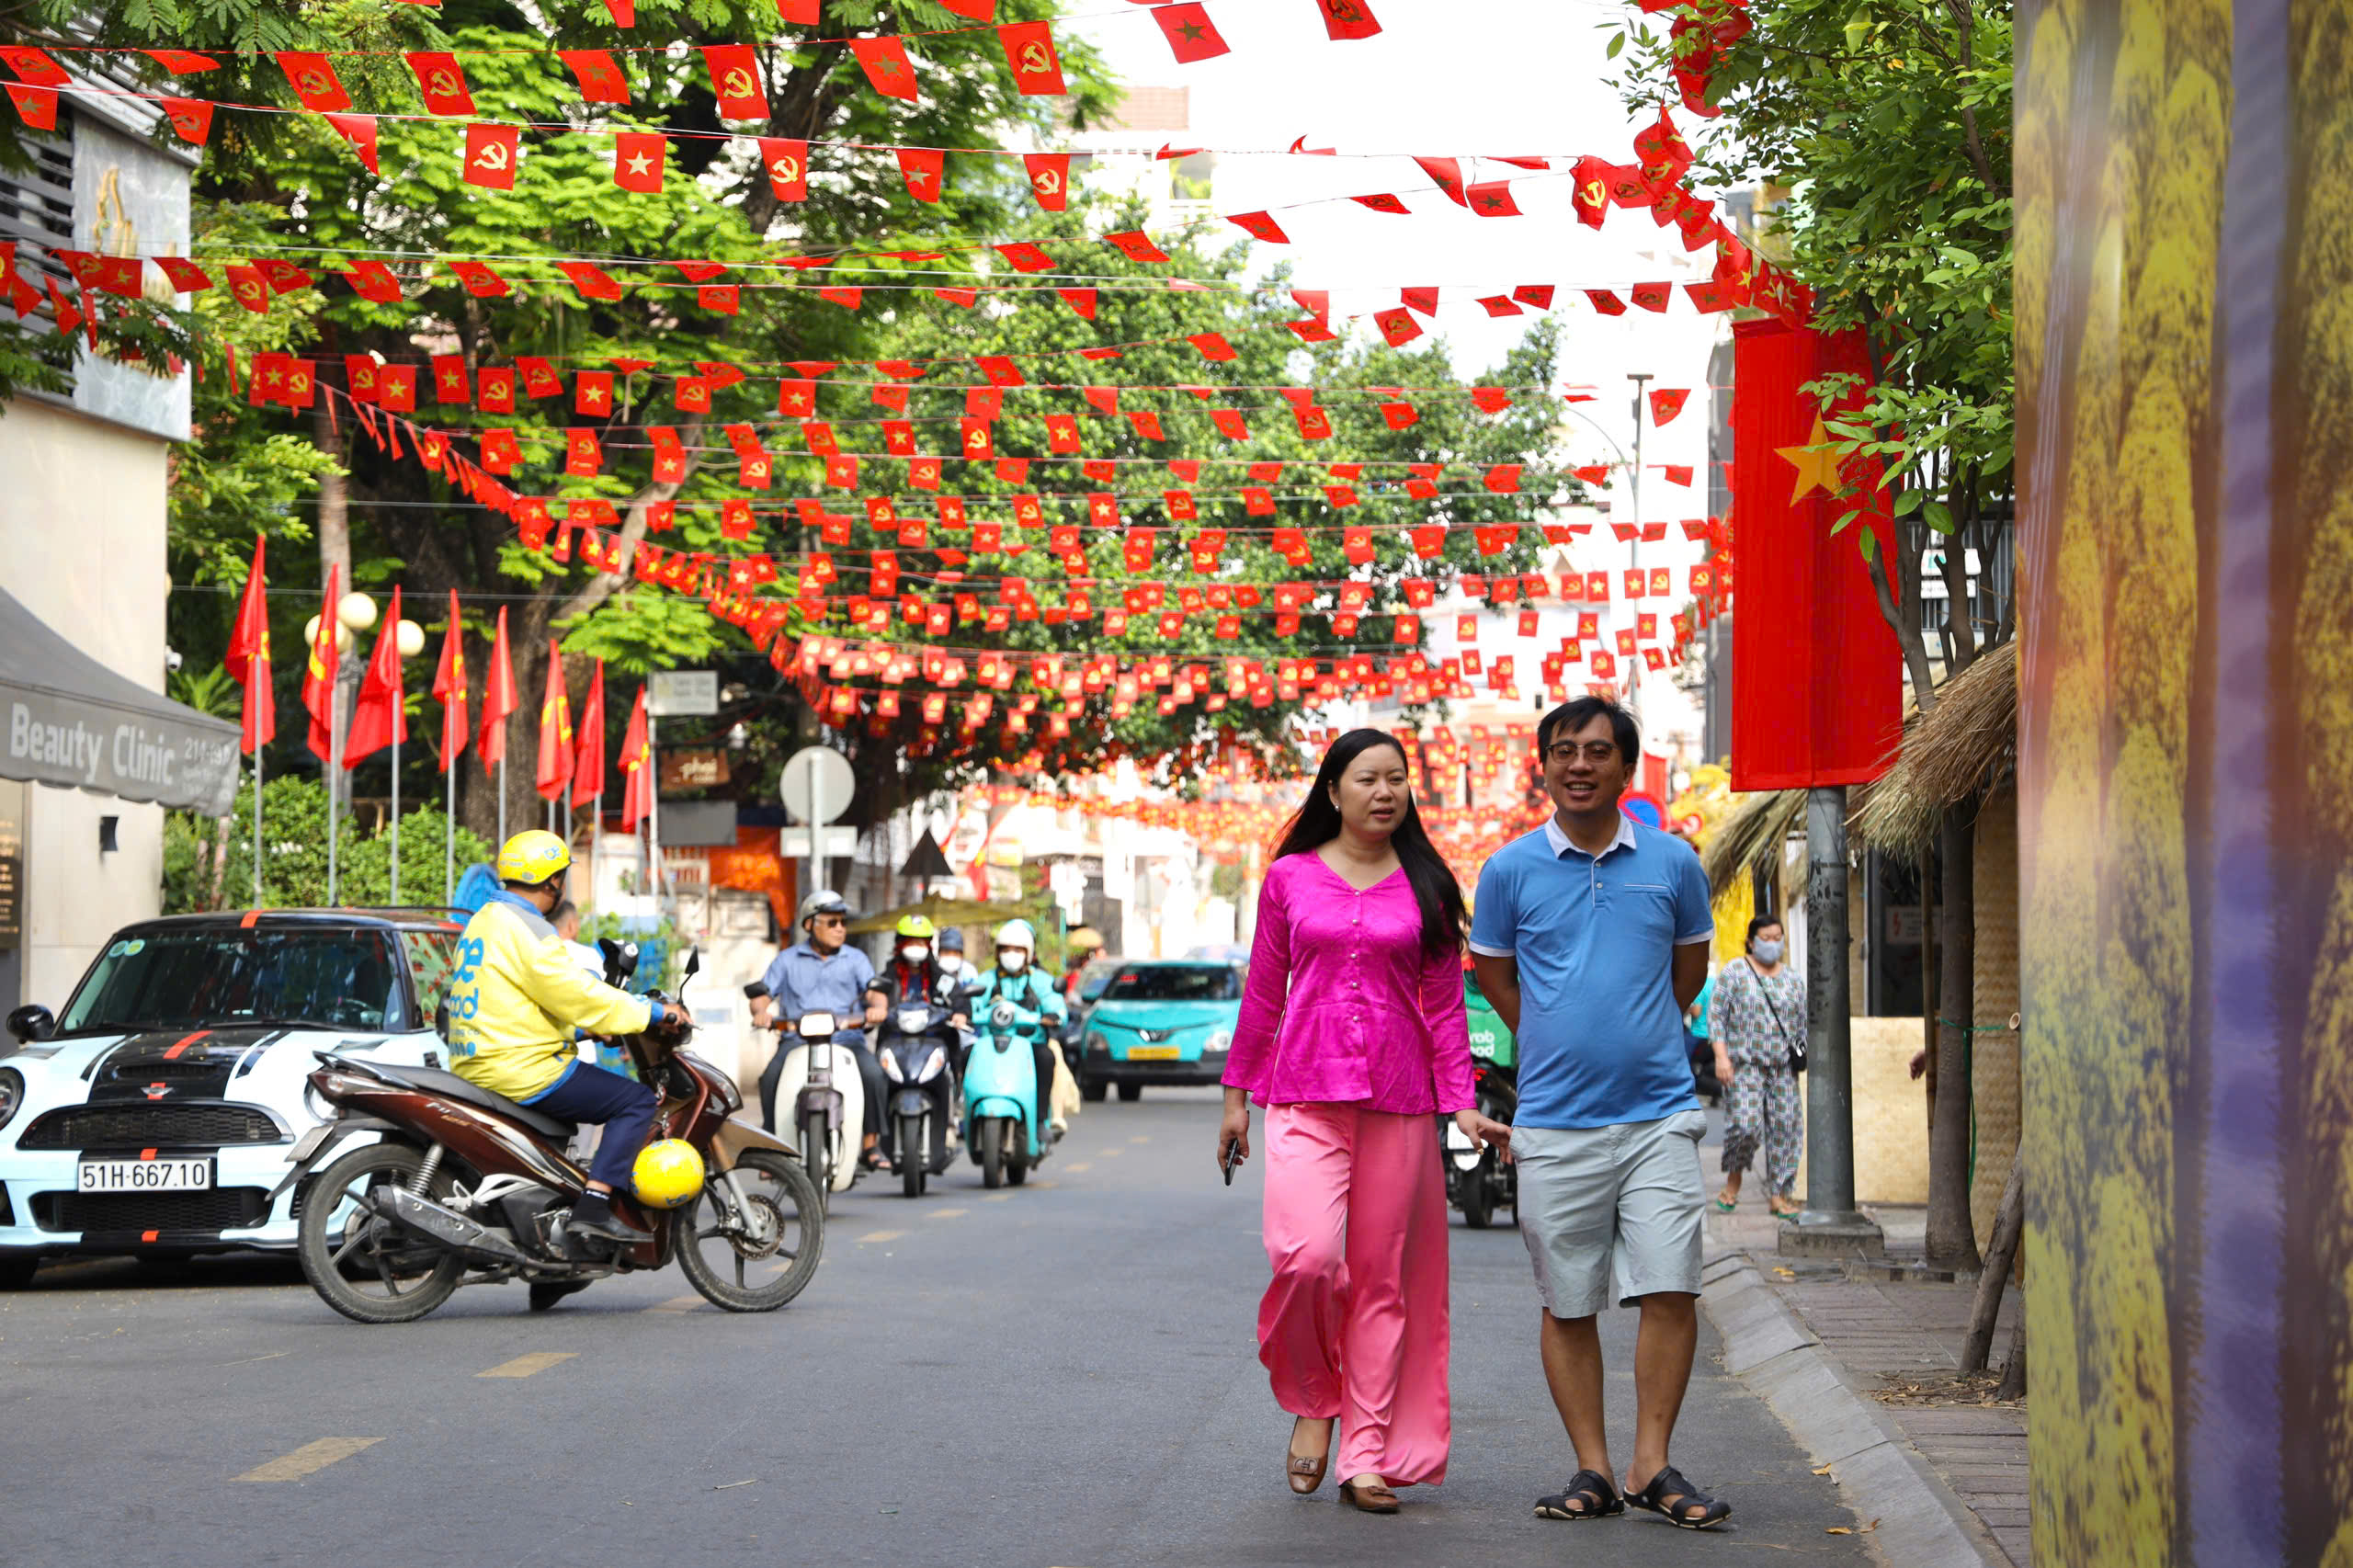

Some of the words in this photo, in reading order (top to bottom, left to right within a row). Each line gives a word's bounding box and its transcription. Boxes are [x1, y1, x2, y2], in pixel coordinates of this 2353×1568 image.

[10, 702, 103, 784] Beauty
[112, 724, 176, 785] Clinic
[1469, 1028, 1495, 1044] rab
[83, 1163, 205, 1188] 51H-667.10
